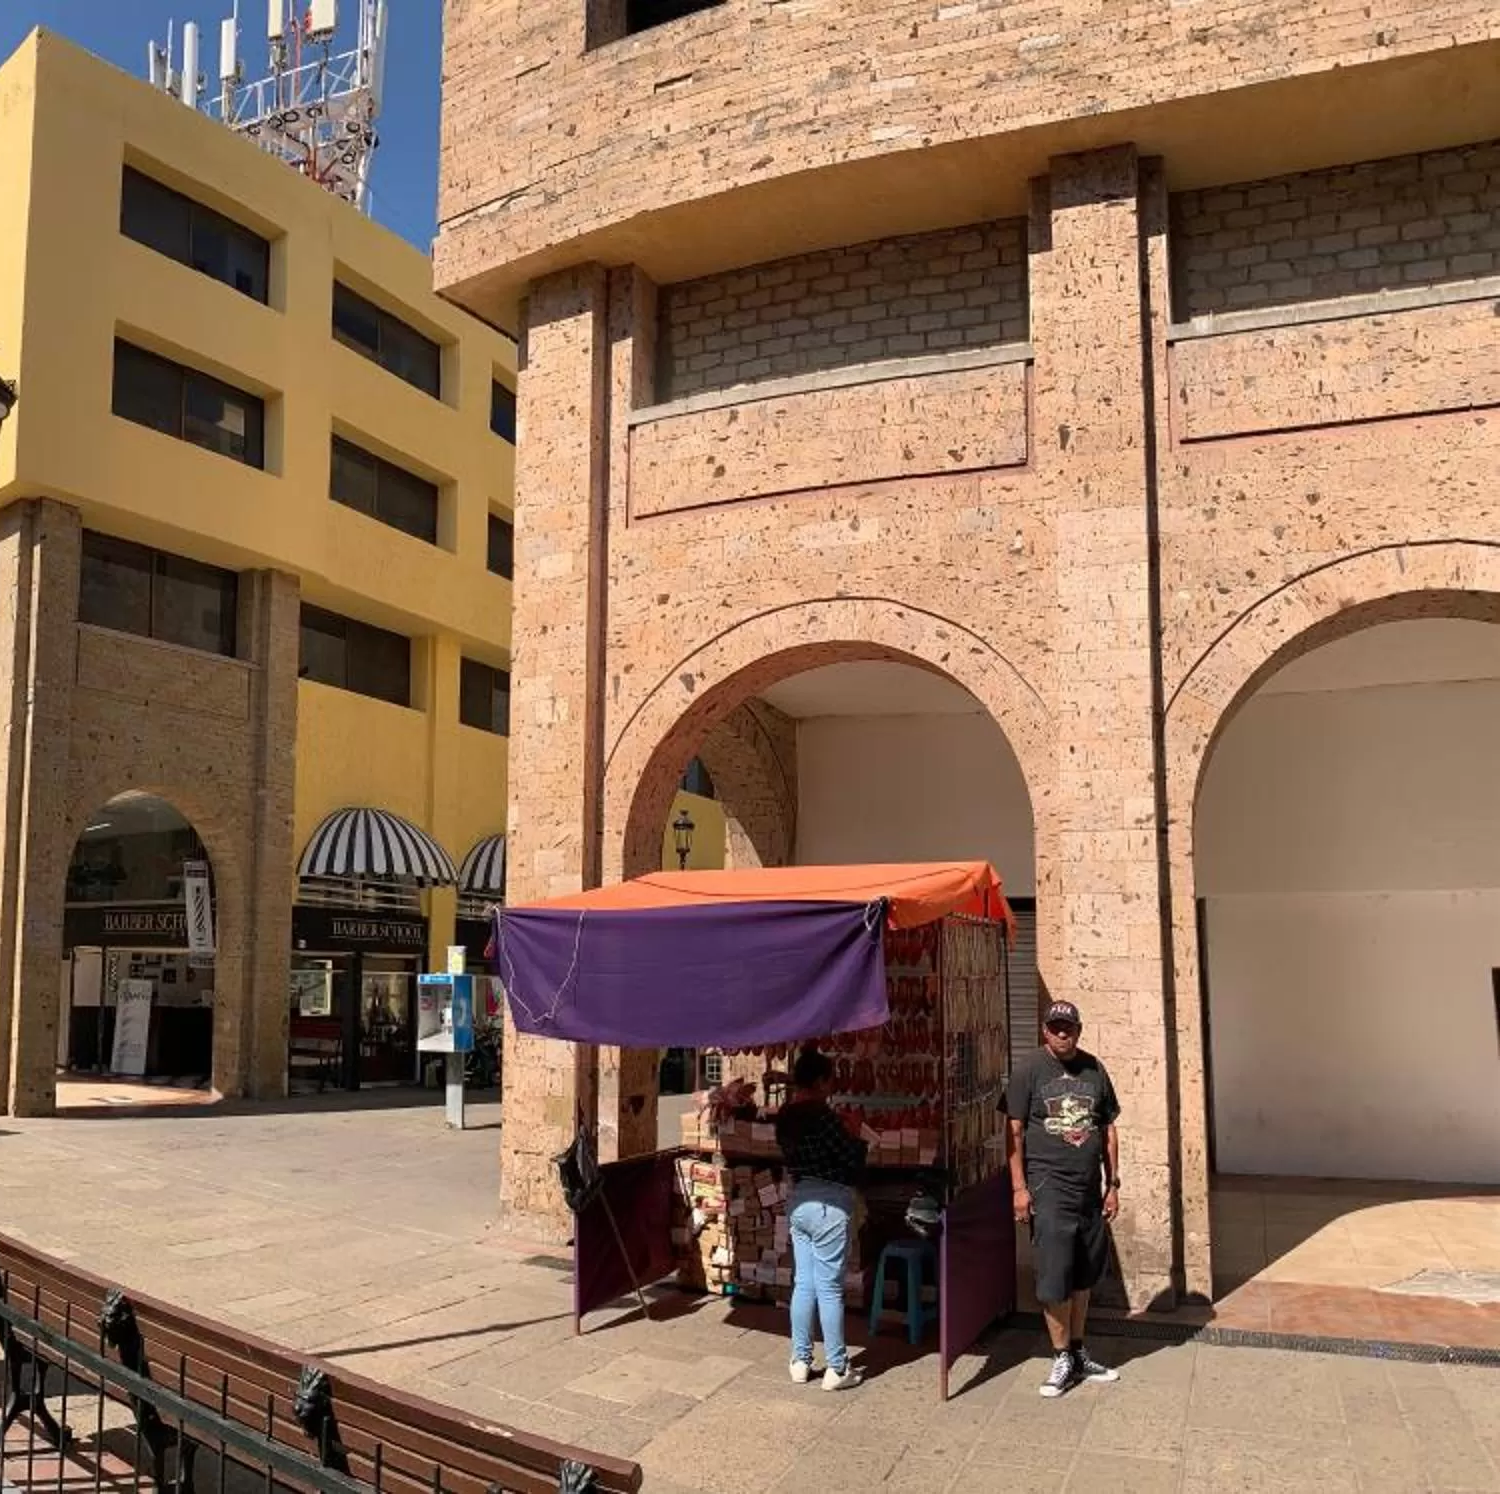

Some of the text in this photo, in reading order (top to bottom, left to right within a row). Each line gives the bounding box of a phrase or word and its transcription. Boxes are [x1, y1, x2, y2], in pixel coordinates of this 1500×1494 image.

[104, 911, 153, 930] BARBER
[332, 919, 422, 938] BARBER SCHOOL
